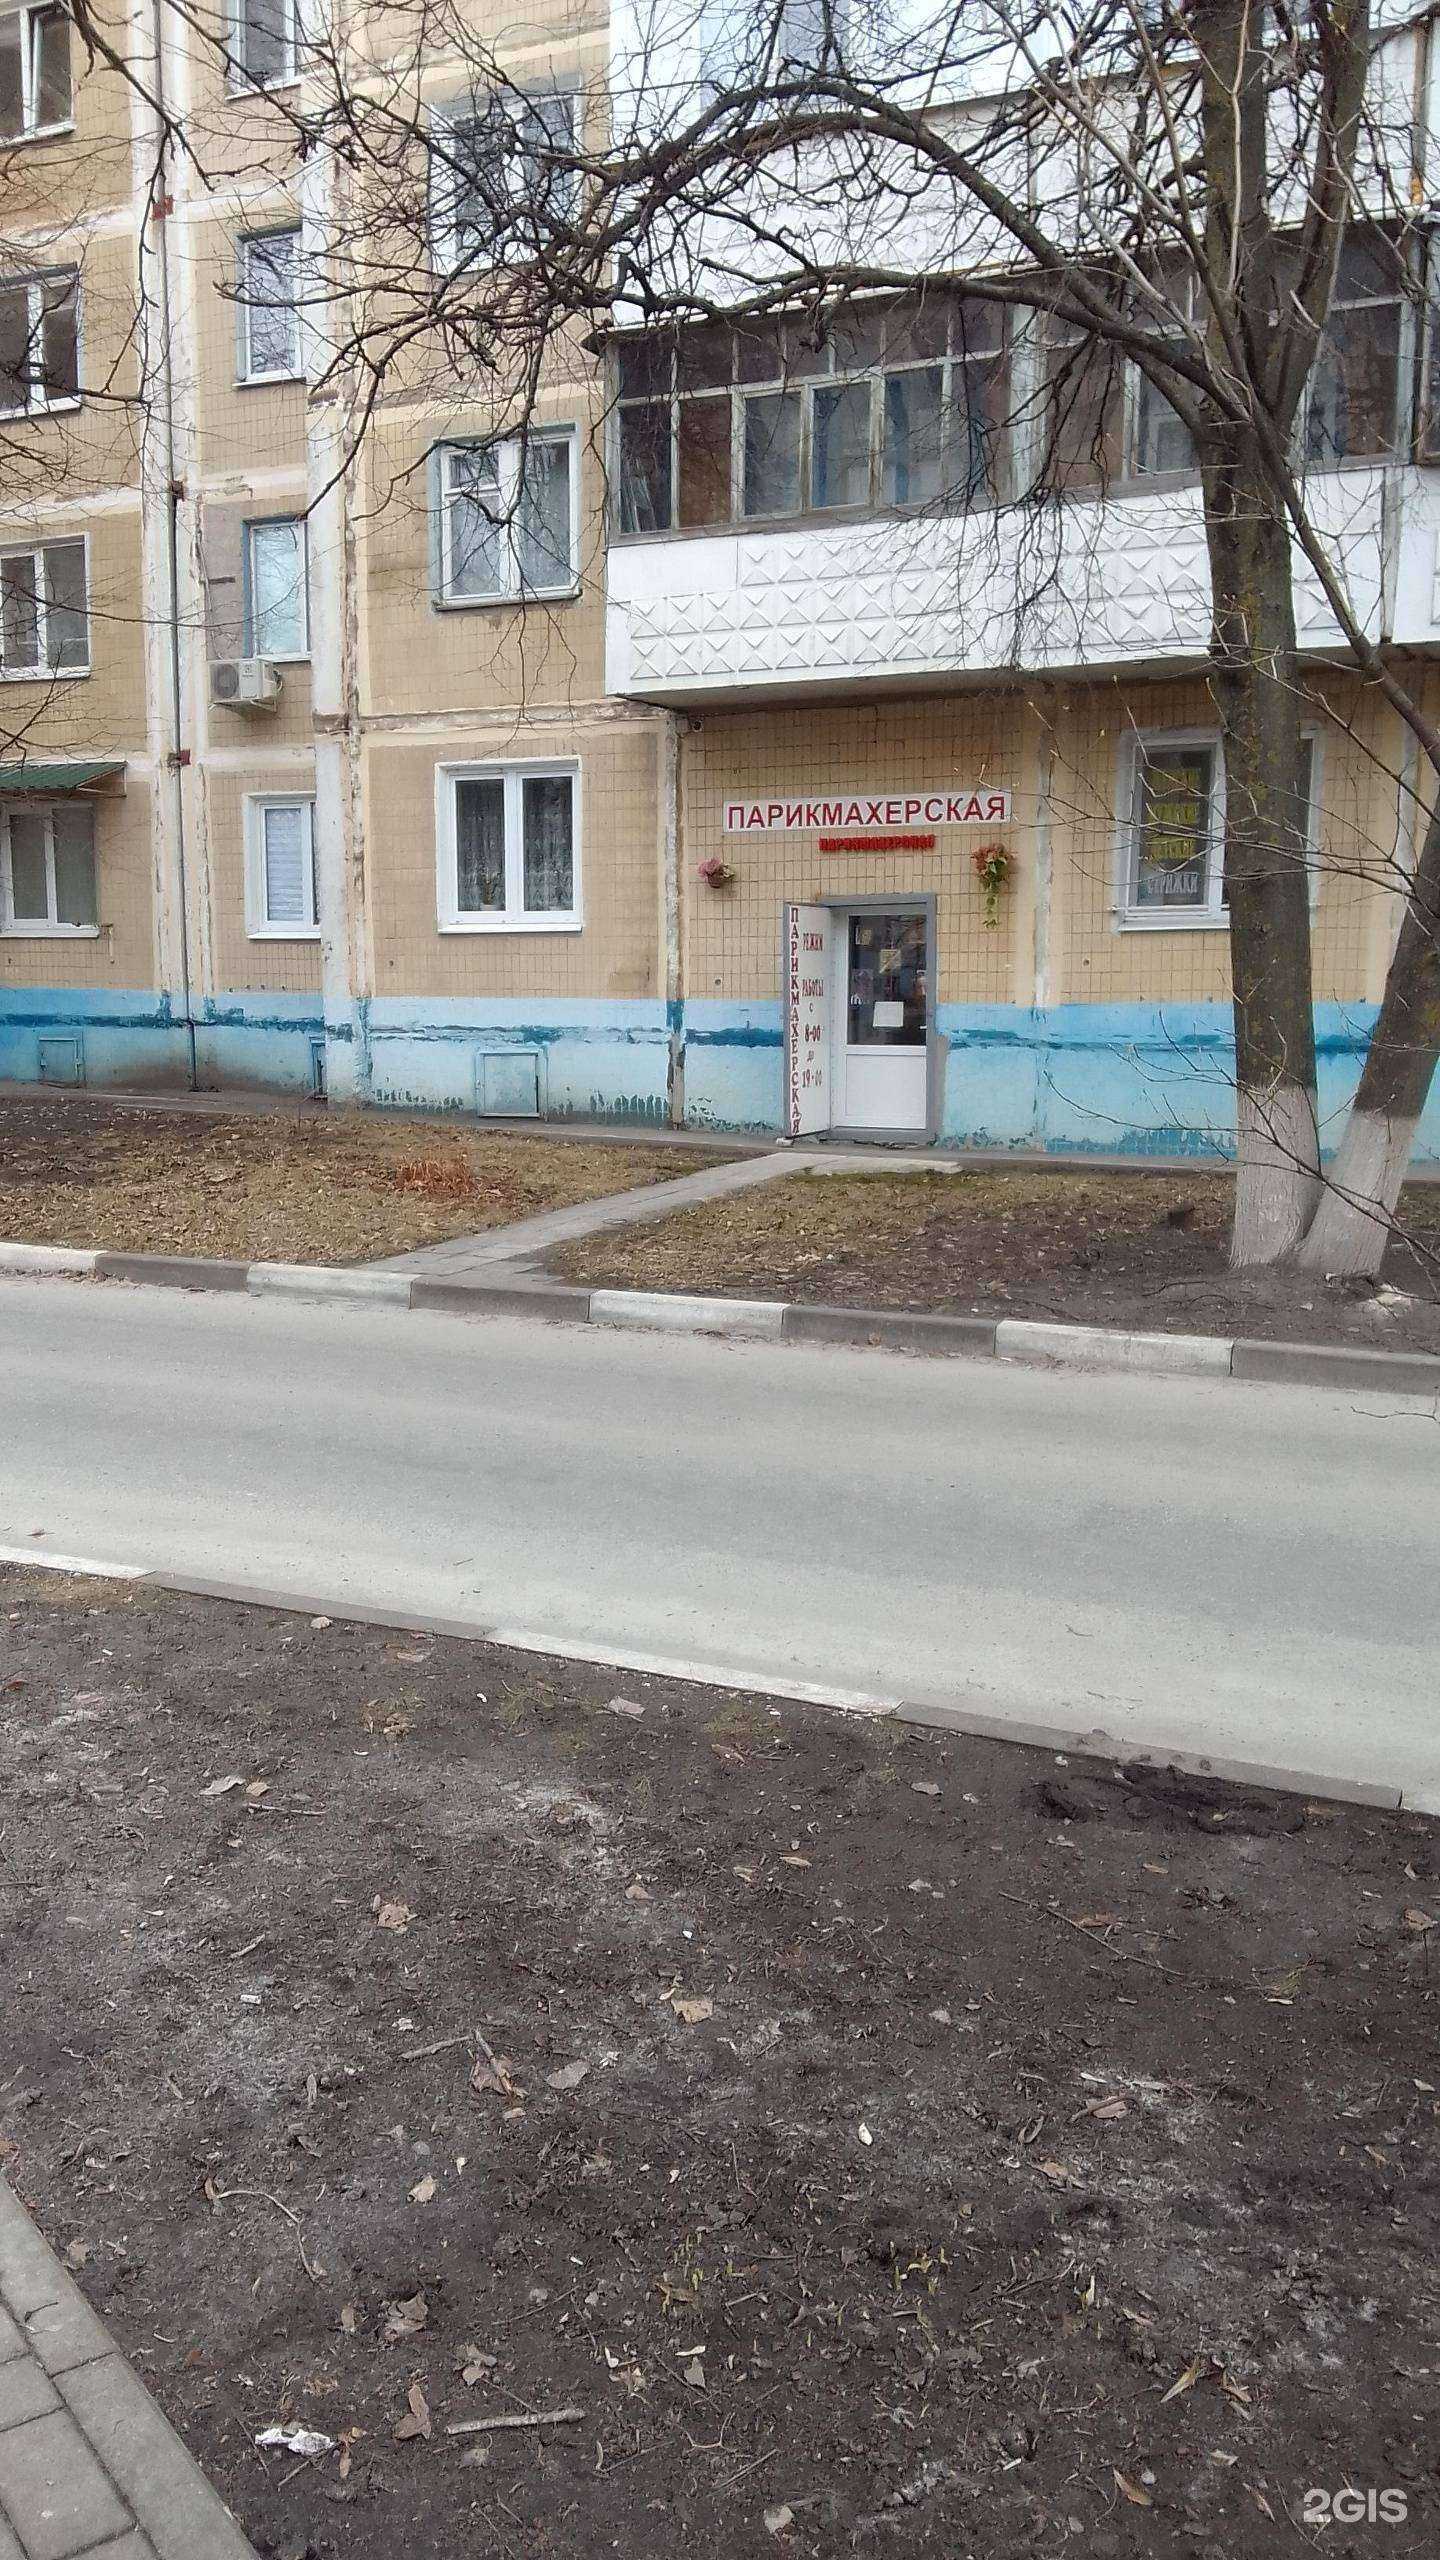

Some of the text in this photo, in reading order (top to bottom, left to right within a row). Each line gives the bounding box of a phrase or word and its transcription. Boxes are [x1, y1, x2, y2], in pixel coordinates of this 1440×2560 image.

[727, 795, 1006, 829] ПАРИКМАХЕРСКАЯ
[801, 978, 824, 997] РАБОТЫ
[790, 907, 801, 1134] ПАРИКМАХЕРСКАЯ
